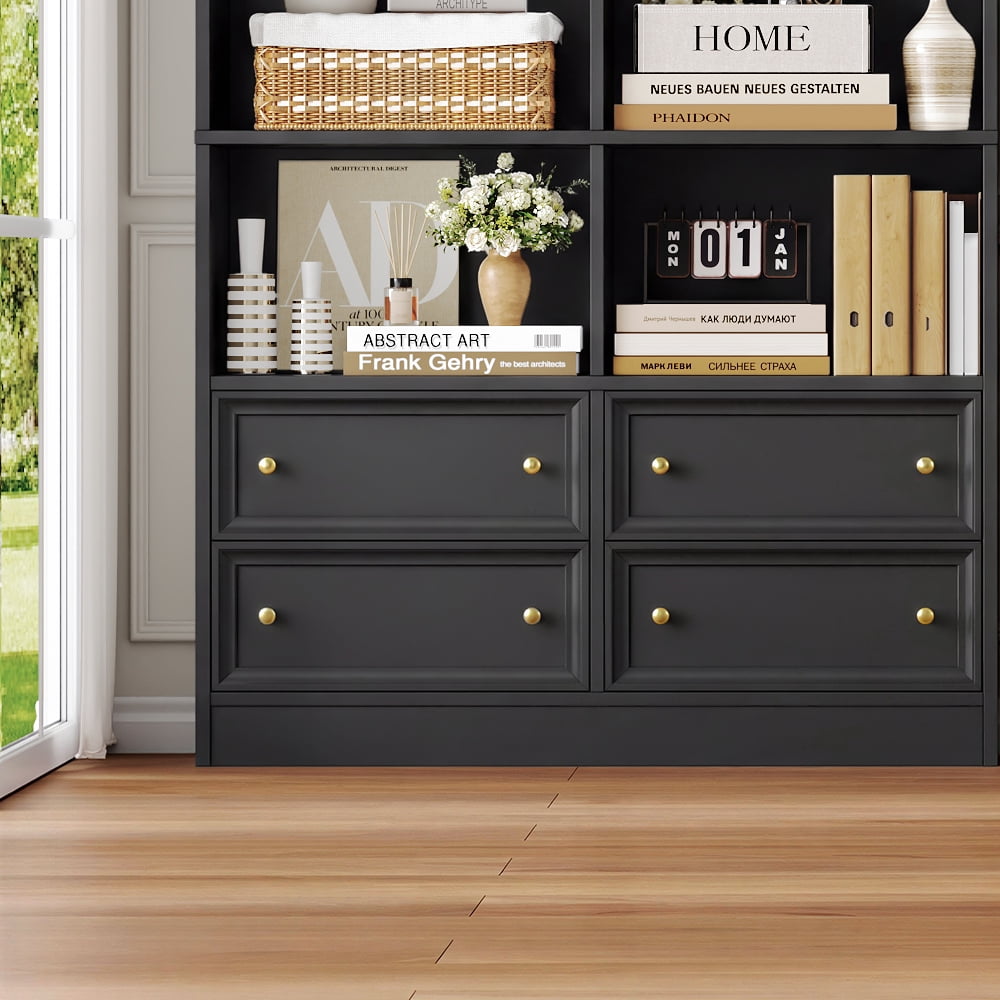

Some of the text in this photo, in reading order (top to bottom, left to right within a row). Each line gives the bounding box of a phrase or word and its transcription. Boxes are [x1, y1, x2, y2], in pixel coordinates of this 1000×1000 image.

[693, 25, 810, 52] HOME
[650, 84, 860, 95] NEUES BAUEN NEUES GESTALTEN
[652, 113, 731, 123] PHAIDON
[667, 228, 788, 270] MON 01 JAN
[349, 308, 362, 320] at
[700, 315, 796, 324] КАК ЛЮДИ ДУМАЮТ
[364, 334, 490, 347] ABSTRACT ART
[359, 354, 421, 370] Frank
[429, 354, 496, 374] Gehry
[641, 362, 796, 370] МАРК ЛЕВИ СИЛЬНЕЕ СТРАХА
